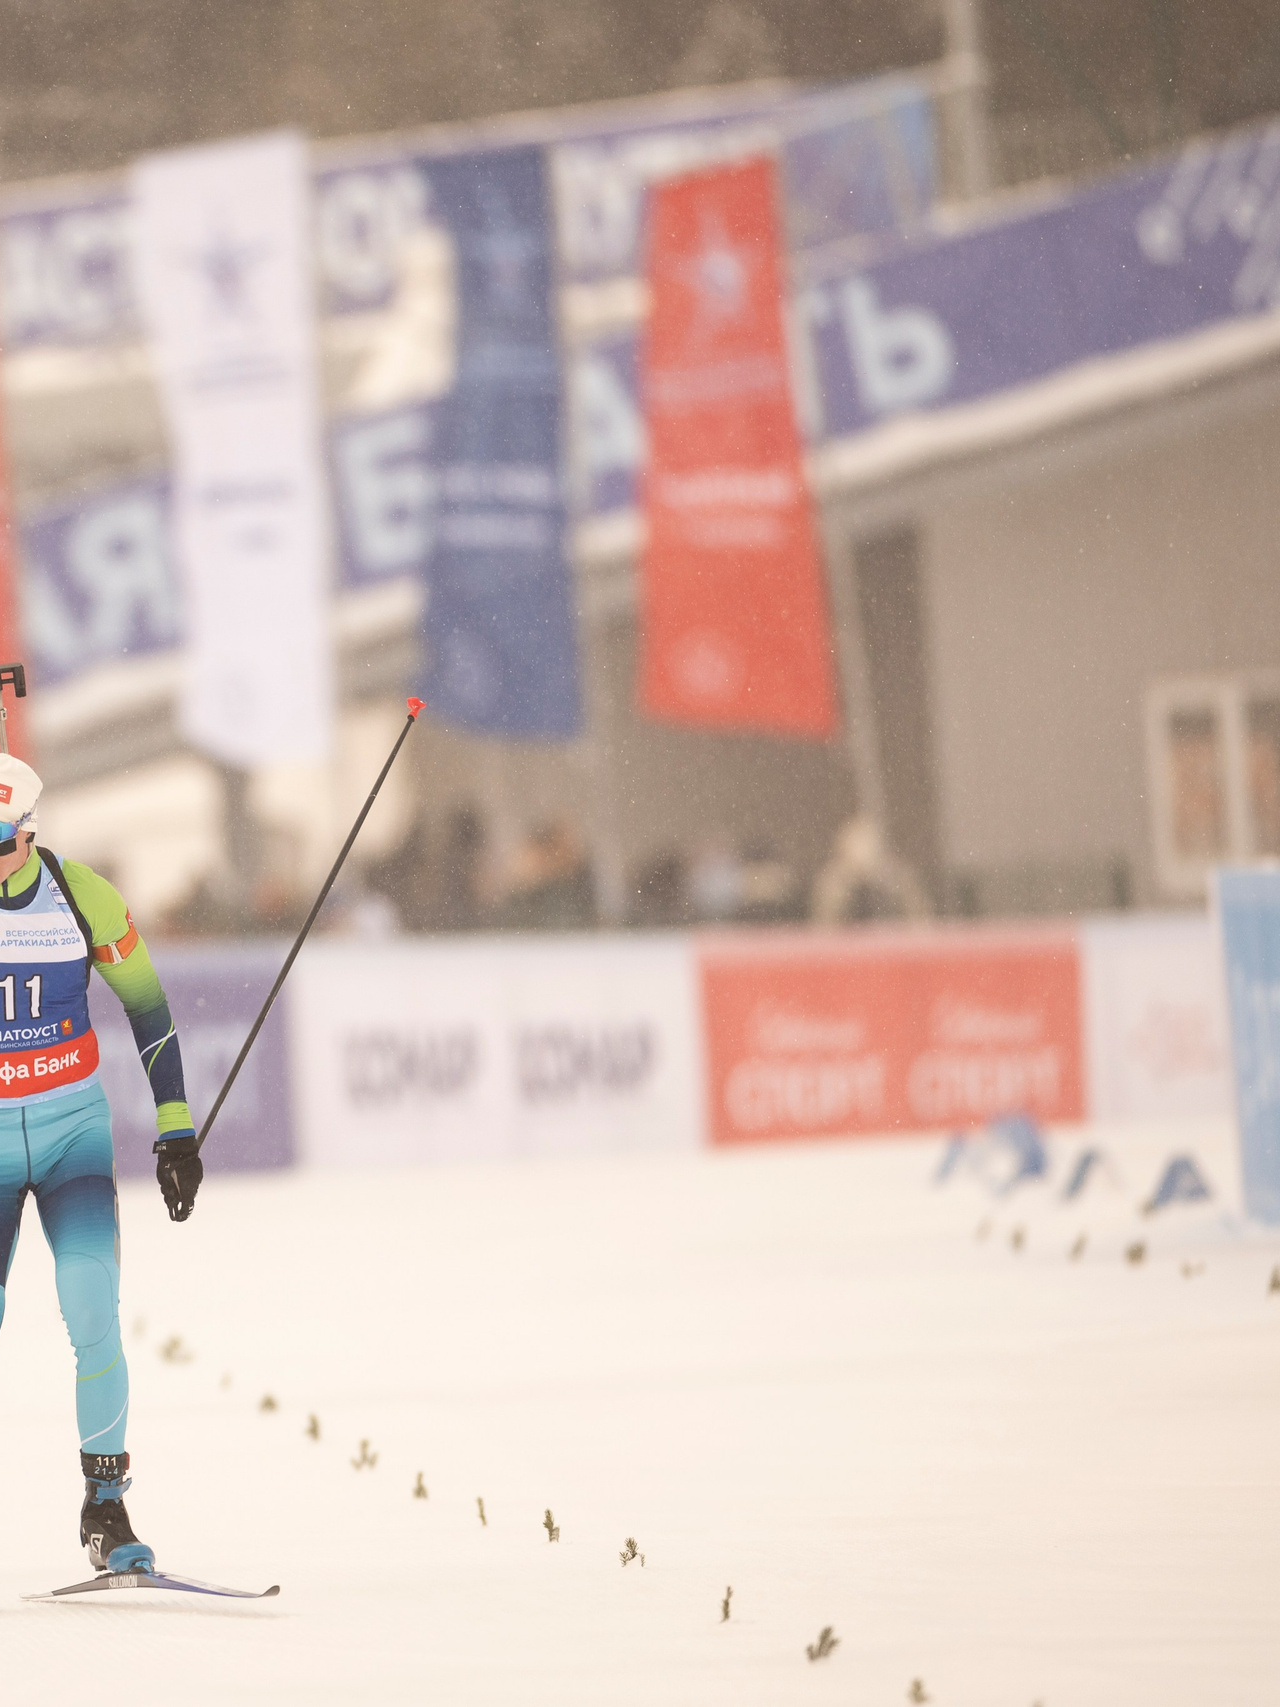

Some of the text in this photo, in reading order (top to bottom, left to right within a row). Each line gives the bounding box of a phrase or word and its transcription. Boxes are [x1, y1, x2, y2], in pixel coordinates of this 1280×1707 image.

[60, 936, 81, 946] 2024
[31, 1036, 59, 1046] ОБЛАСТЬ
[33, 1049, 81, 1077] Банк
[96, 1456, 117, 1467] 111
[94, 1466, 118, 1476] 21-4
[108, 1575, 138, 1589] SALOMON
